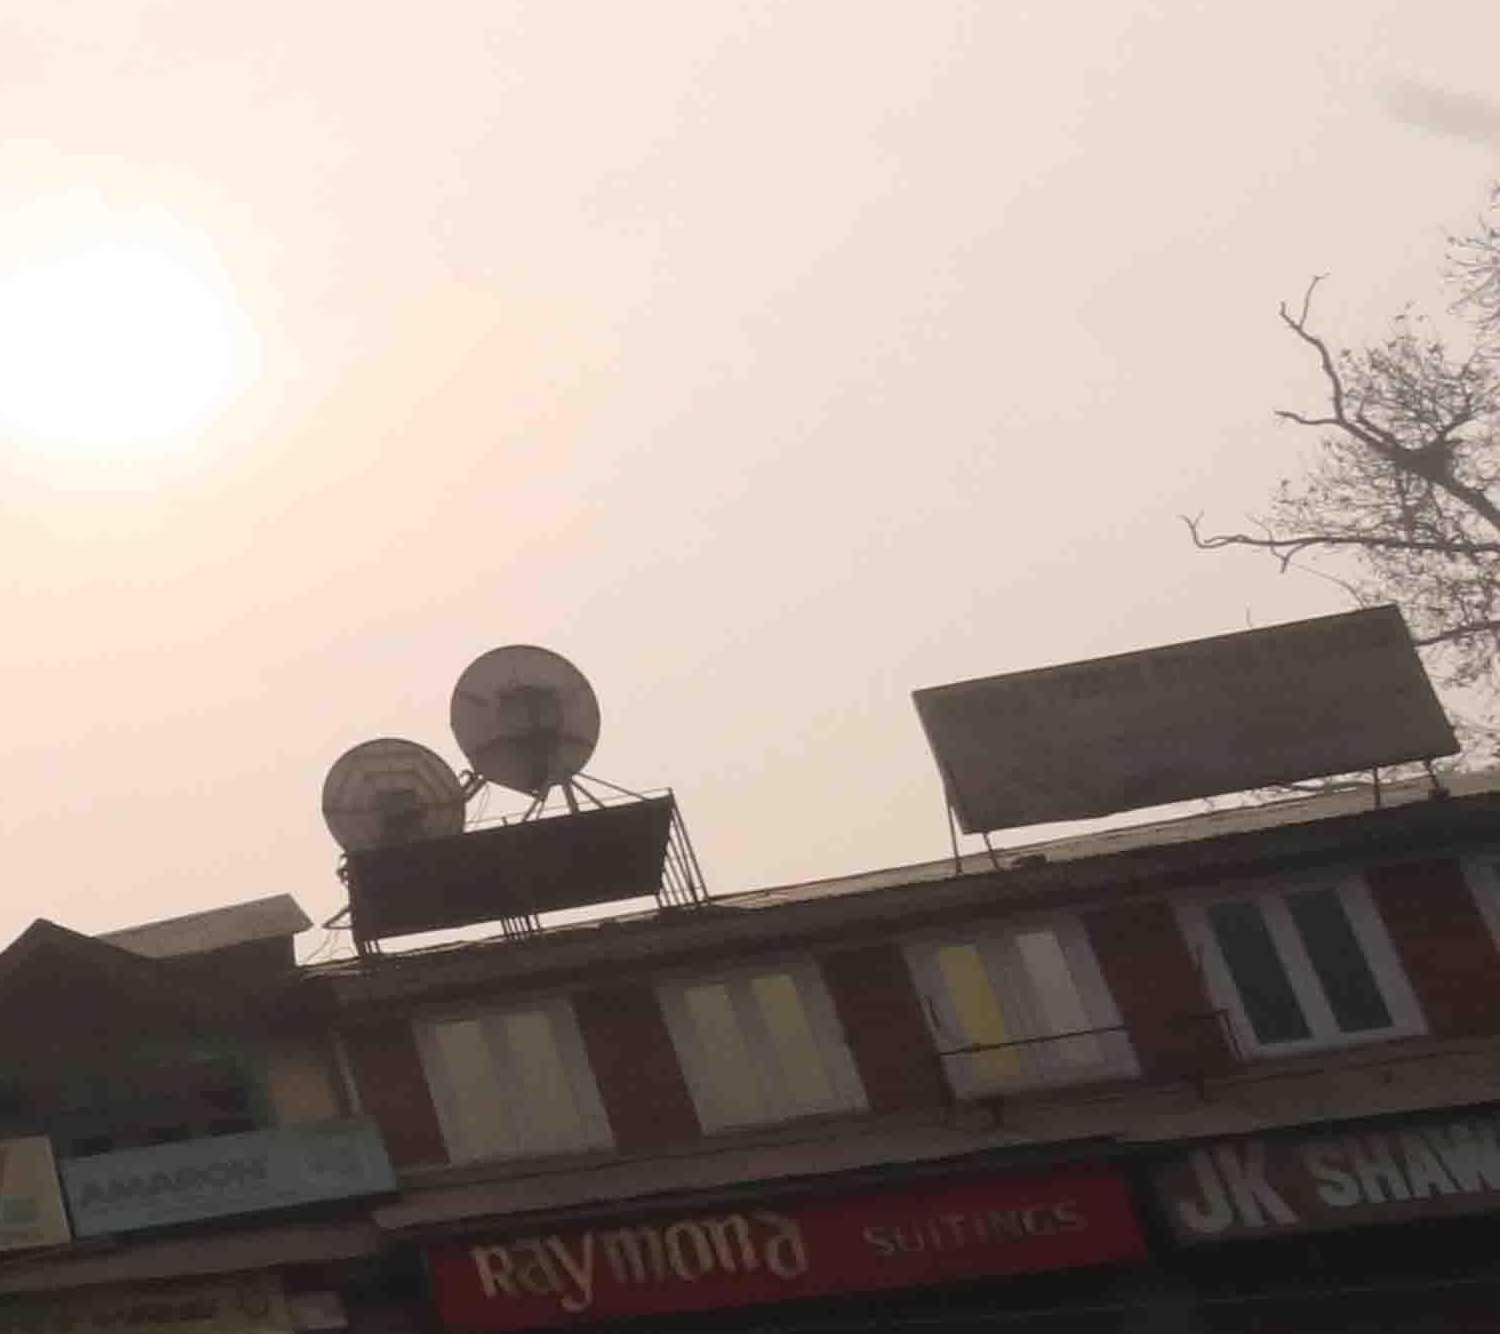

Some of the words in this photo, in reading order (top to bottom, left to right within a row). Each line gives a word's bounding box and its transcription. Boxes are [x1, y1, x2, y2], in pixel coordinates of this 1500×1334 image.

[78, 1158, 268, 1208] AMARON
[1175, 1145, 1300, 1234] JK
[469, 1212, 808, 1313] Raymond
[860, 1198, 1087, 1257] SUITINGS
